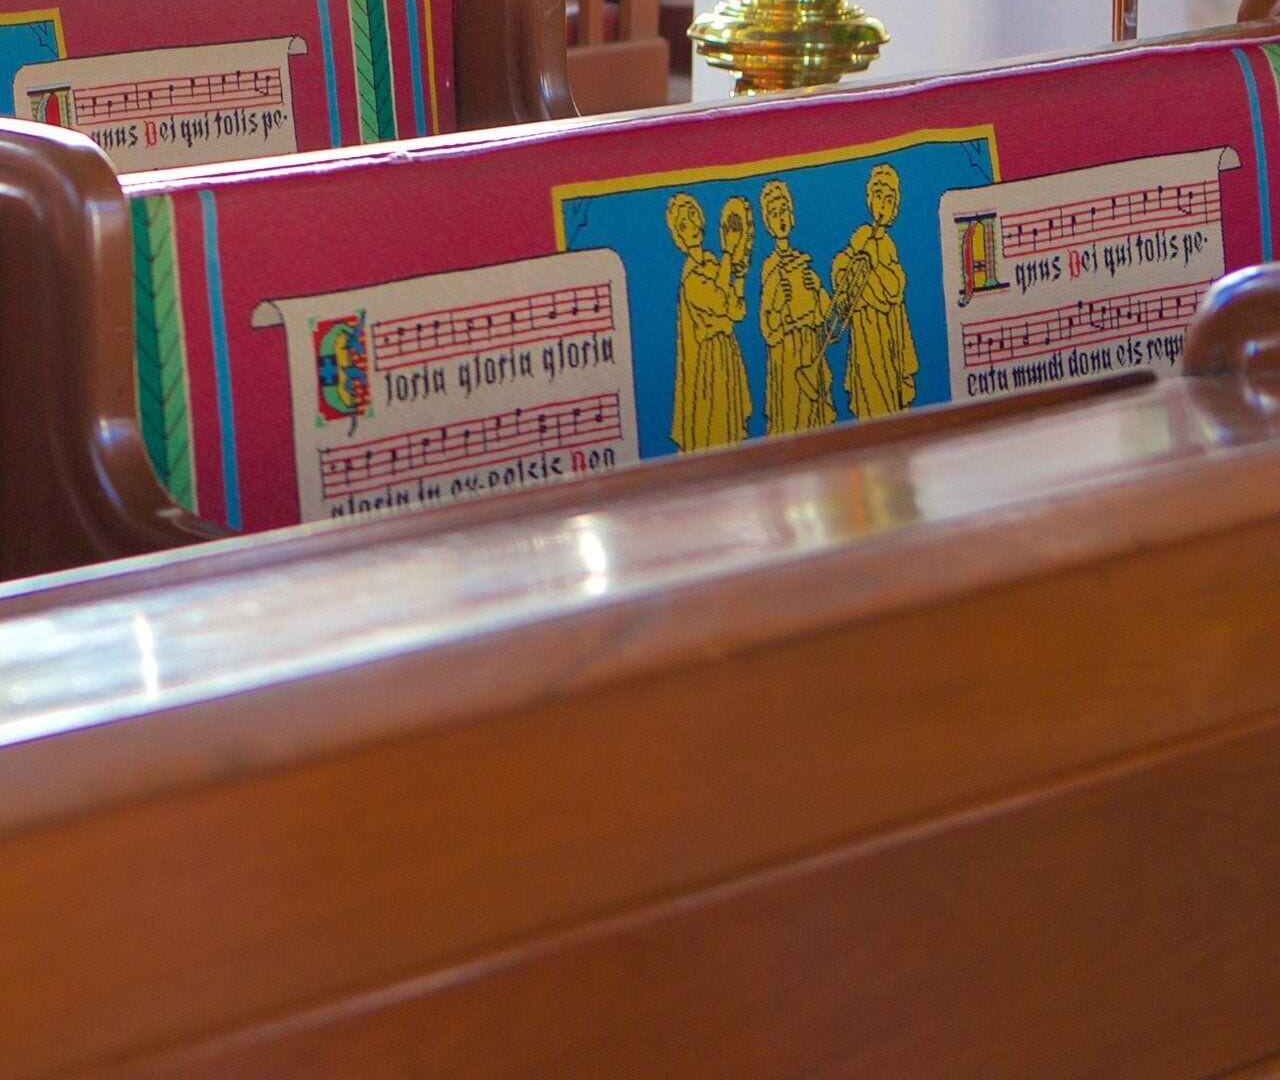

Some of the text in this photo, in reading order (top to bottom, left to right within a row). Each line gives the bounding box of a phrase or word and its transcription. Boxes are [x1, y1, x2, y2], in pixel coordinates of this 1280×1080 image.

[144, 114, 177, 149] Dei
[181, 110, 210, 149] qui
[214, 106, 258, 139] tolis
[1067, 240, 1098, 281] Dei
[1104, 234, 1132, 278] qui
[1136, 227, 1180, 266] tolis
[459, 346, 534, 400] gloria
[542, 330, 616, 383] gloria
[1012, 349, 1065, 389] mundi
